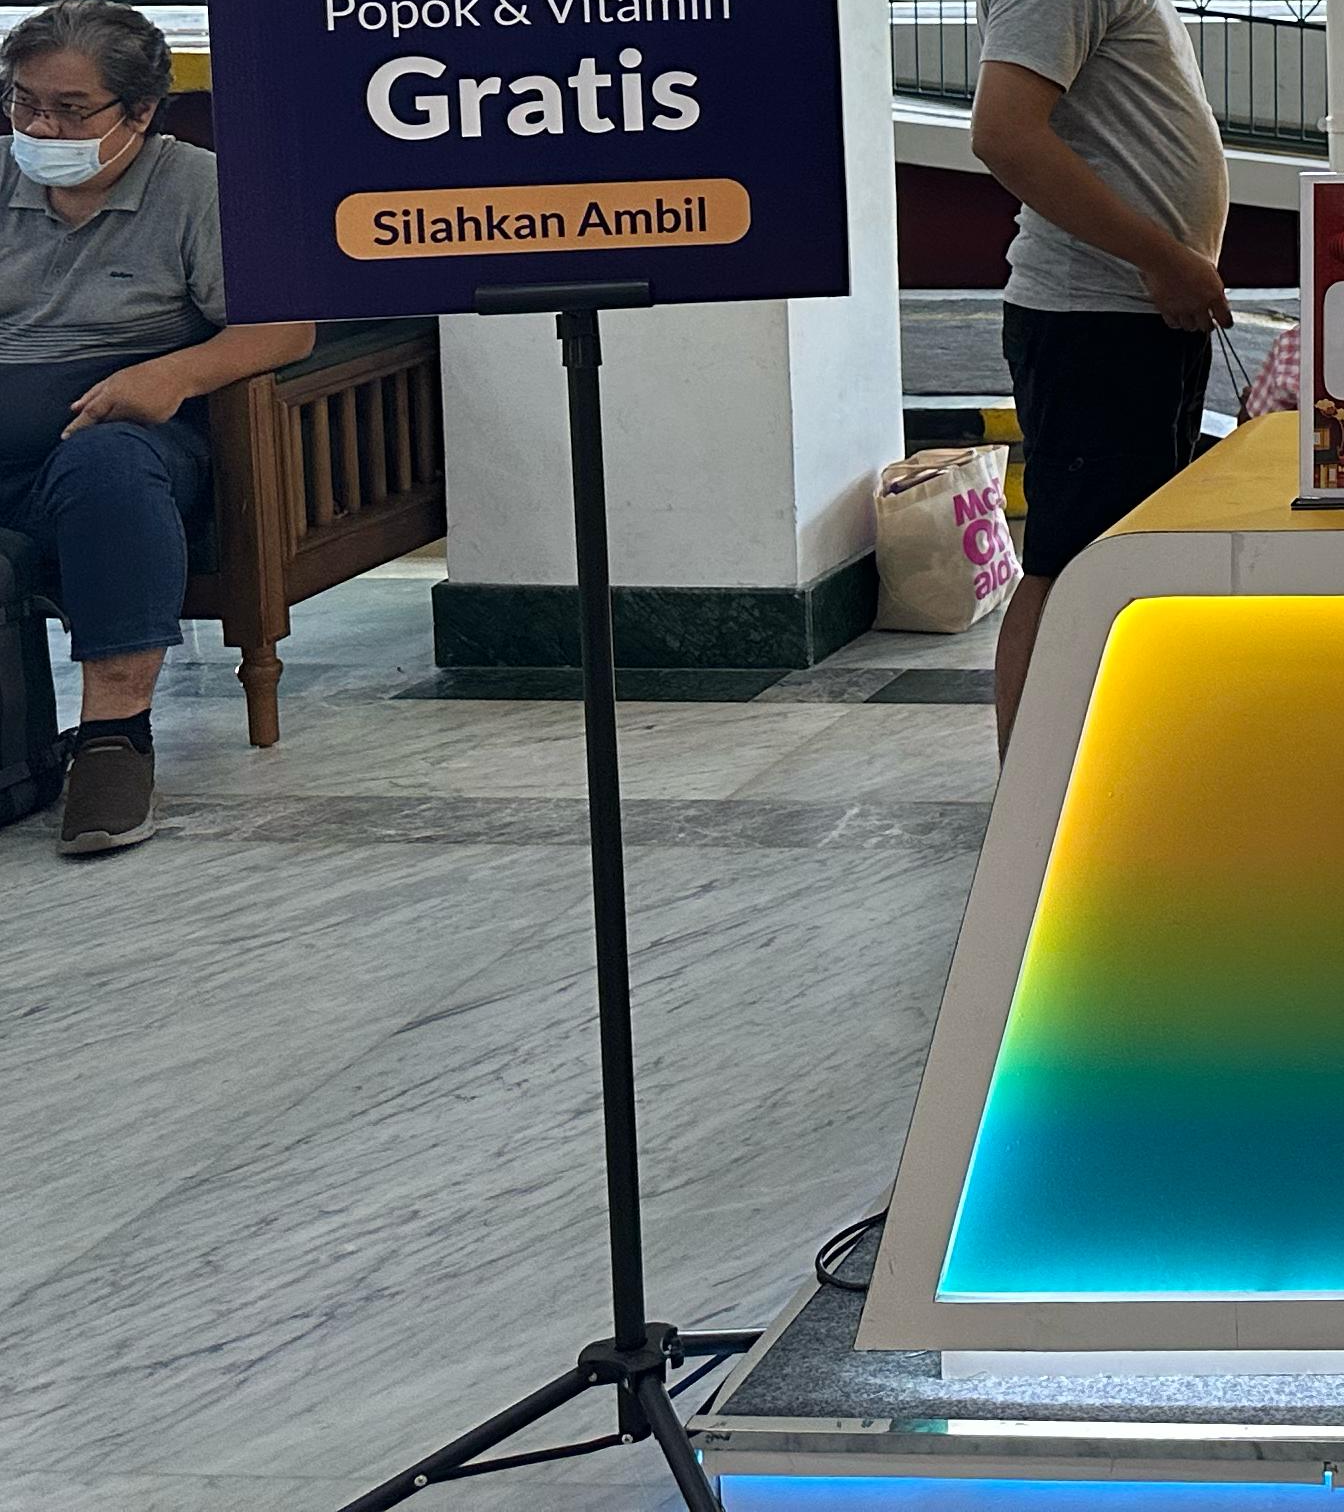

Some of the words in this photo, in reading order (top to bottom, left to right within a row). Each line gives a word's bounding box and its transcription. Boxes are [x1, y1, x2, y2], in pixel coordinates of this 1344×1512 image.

[365, 48, 701, 141] Gratis
[372, 200, 566, 247] Silahkan
[578, 194, 708, 239] Ambil
